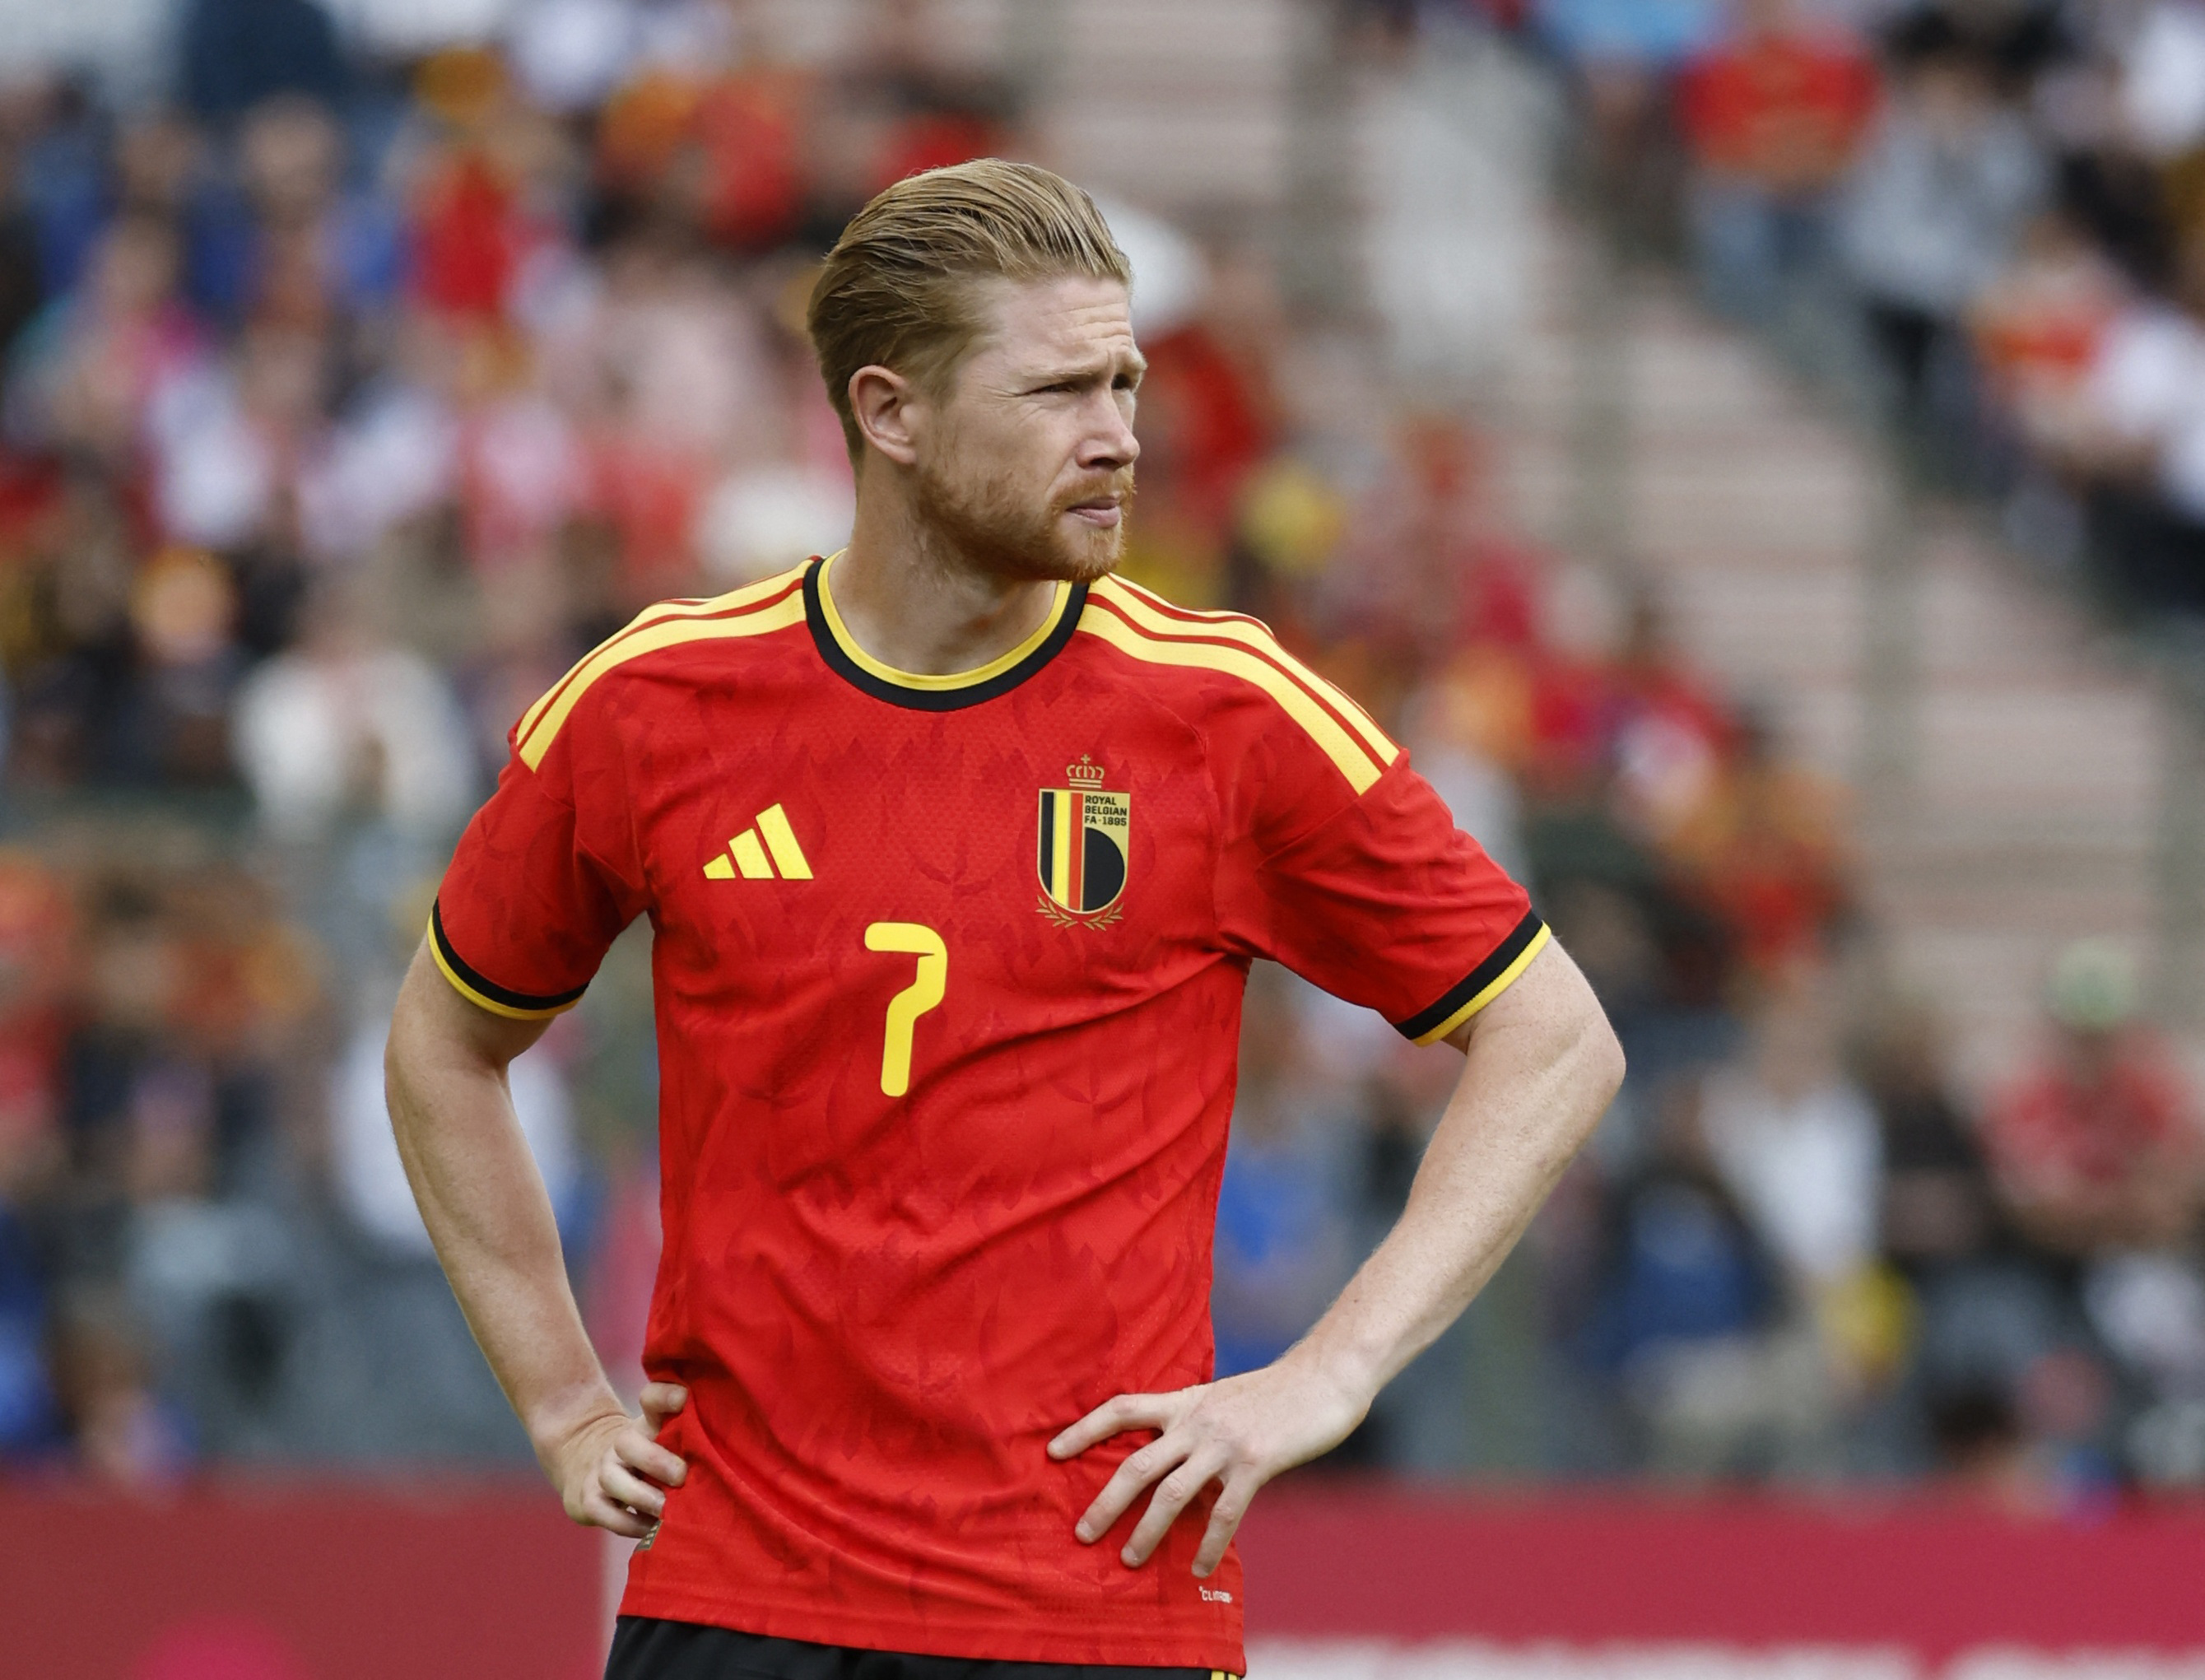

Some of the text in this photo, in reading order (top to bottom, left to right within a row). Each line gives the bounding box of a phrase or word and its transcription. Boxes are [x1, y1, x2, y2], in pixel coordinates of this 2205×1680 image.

[1085, 795, 1117, 805] ROYAL
[1085, 805, 1127, 816] BELGIAN
[1084, 815, 1127, 826] FA 1895
[864, 922, 947, 1096] 7
